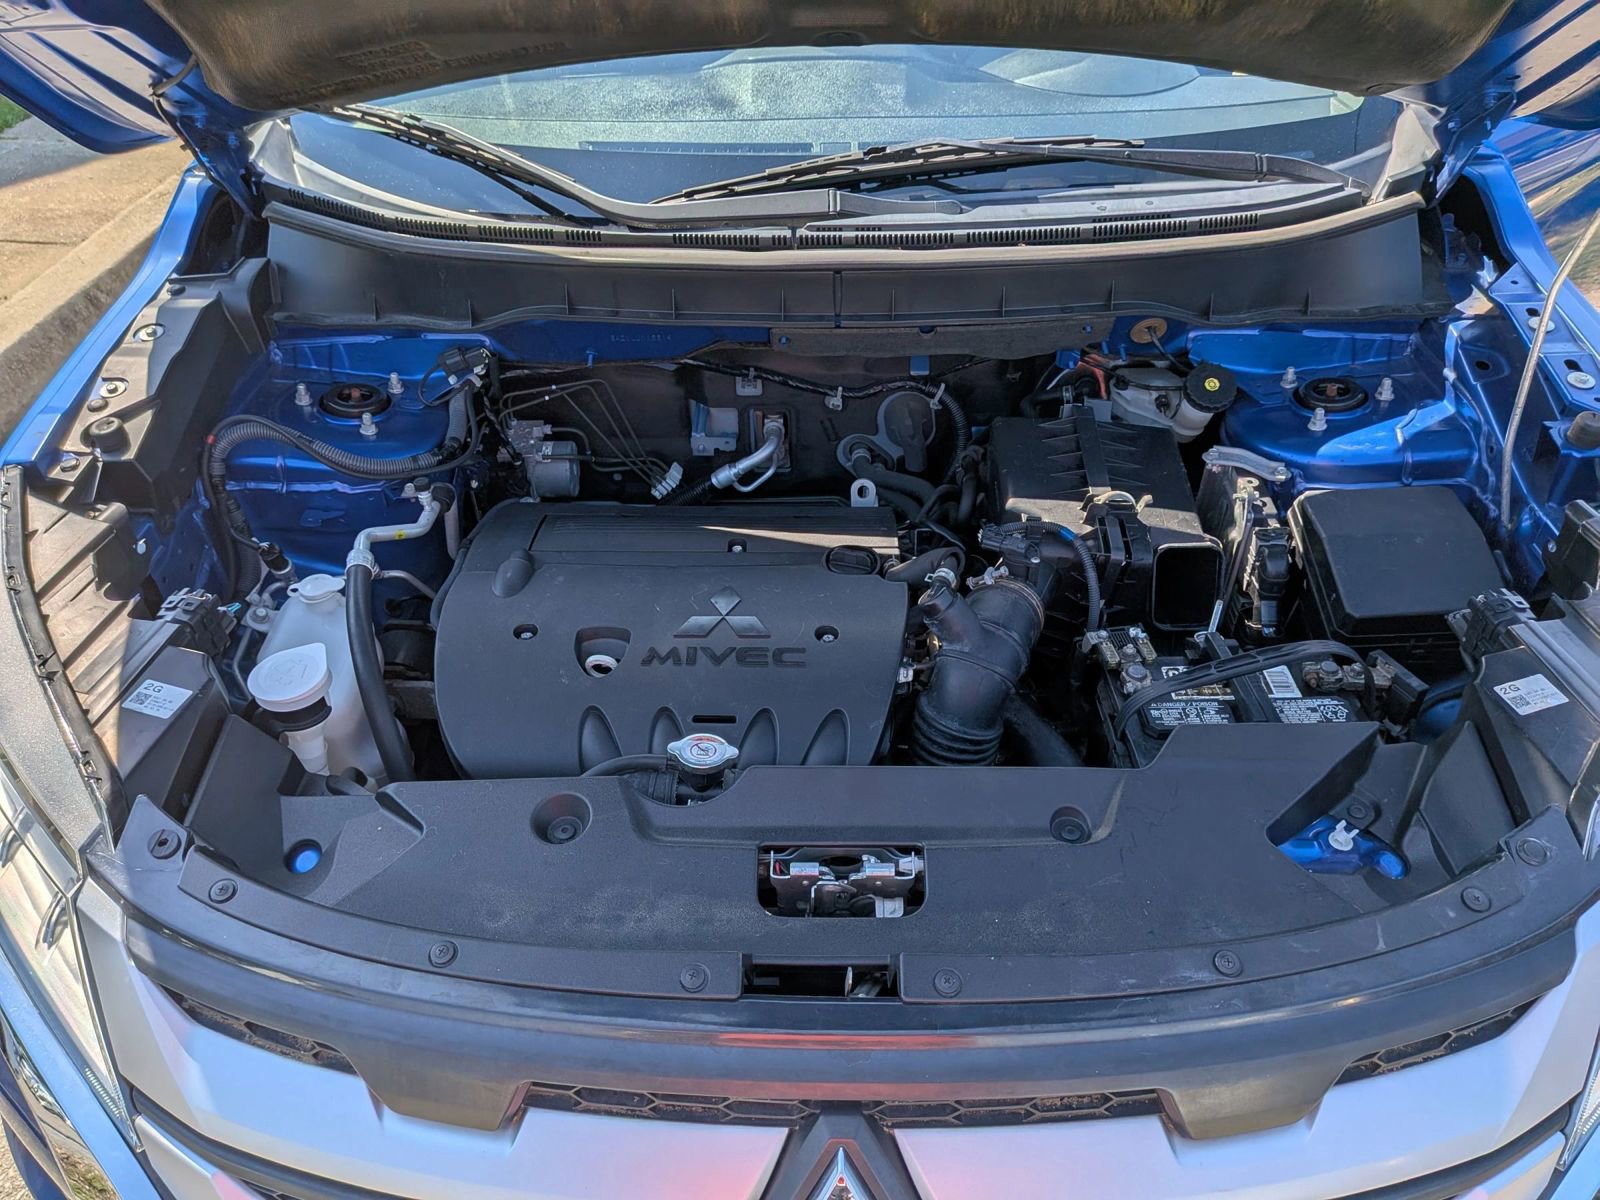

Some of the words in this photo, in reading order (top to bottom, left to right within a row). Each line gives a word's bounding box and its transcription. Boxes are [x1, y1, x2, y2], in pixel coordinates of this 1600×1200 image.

[640, 646, 807, 667] MIVEC
[143, 683, 164, 694] 2G
[1500, 684, 1521, 695] 2G
